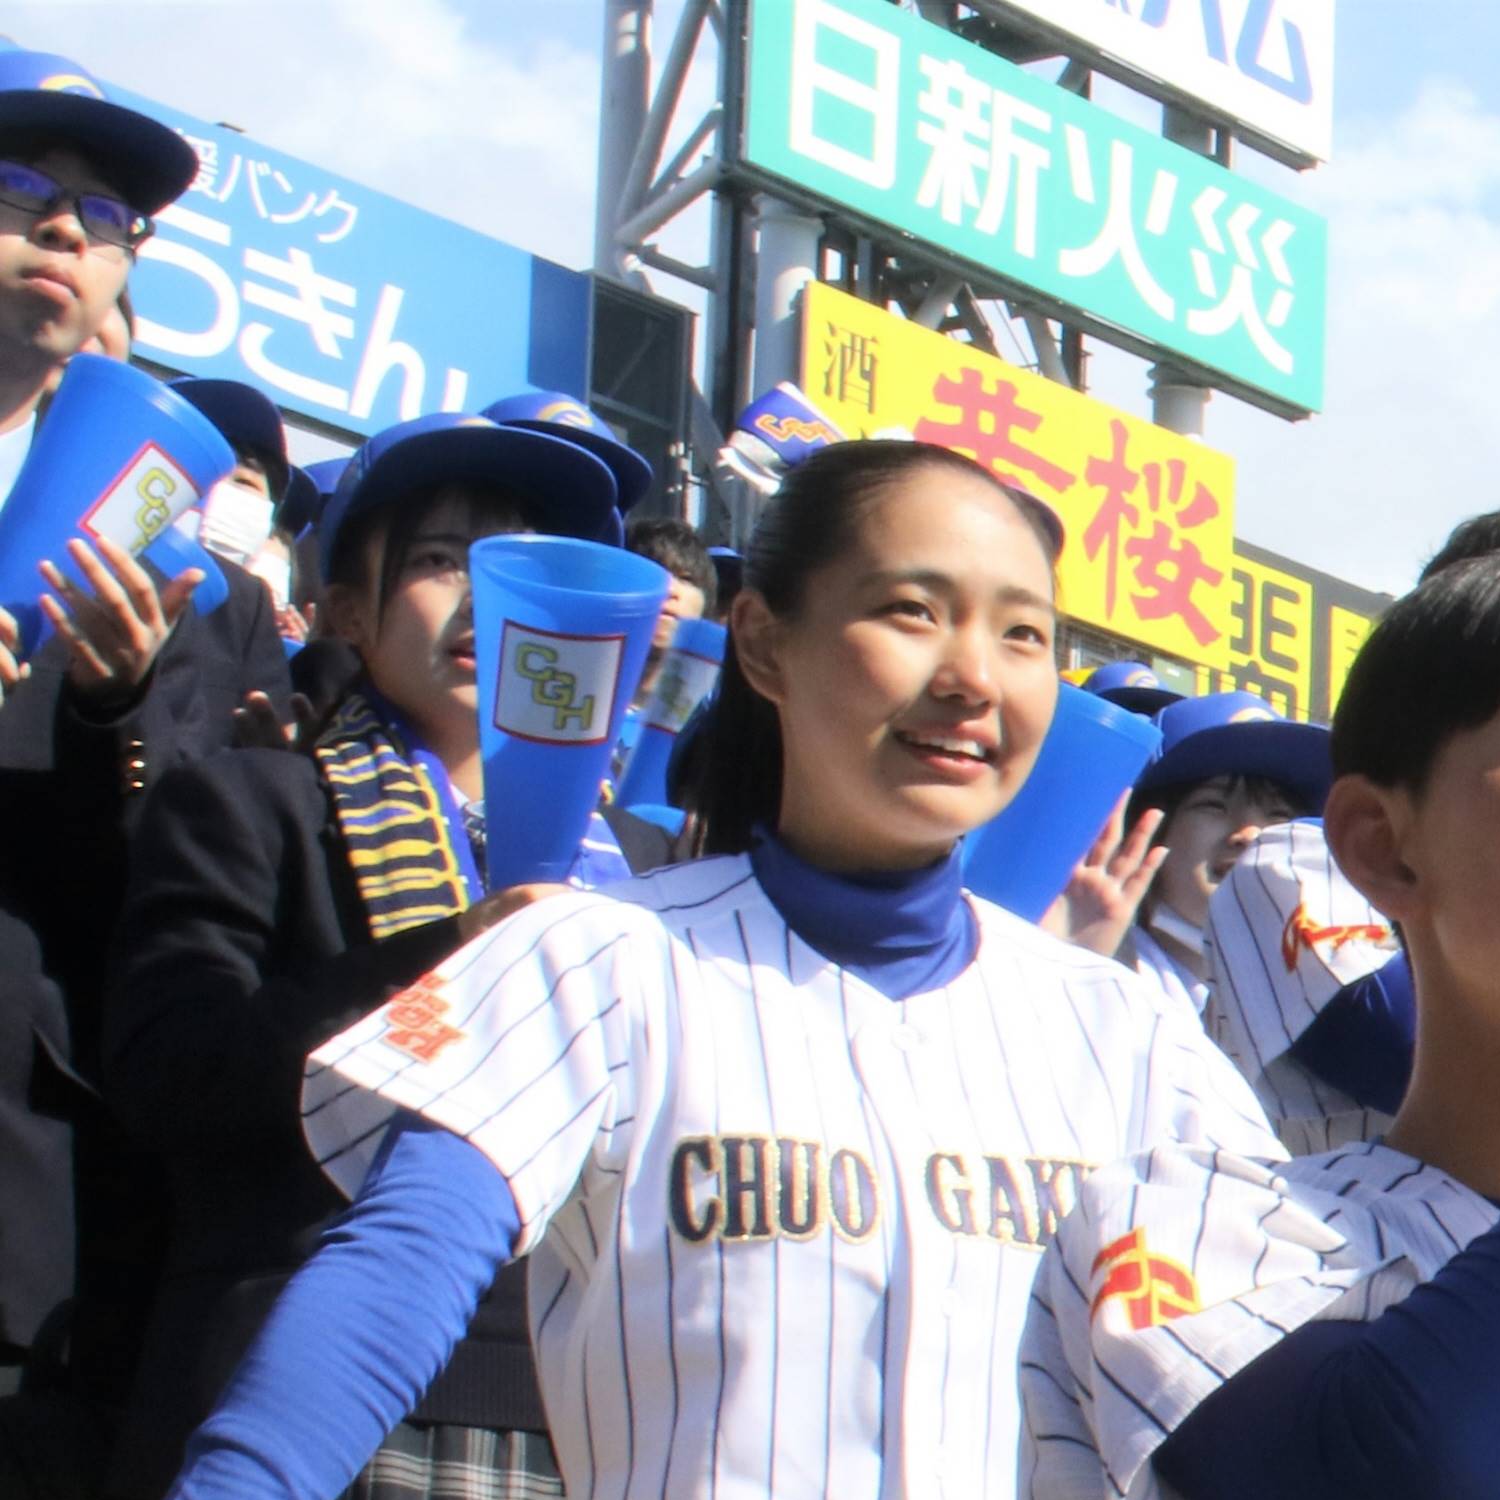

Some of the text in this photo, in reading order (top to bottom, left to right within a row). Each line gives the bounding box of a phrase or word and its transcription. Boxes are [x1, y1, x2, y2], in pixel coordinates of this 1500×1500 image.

[788, 0, 1297, 375] 日新火災
[515, 641, 594, 731] CGH
[667, 1133, 880, 1246] CHUO
